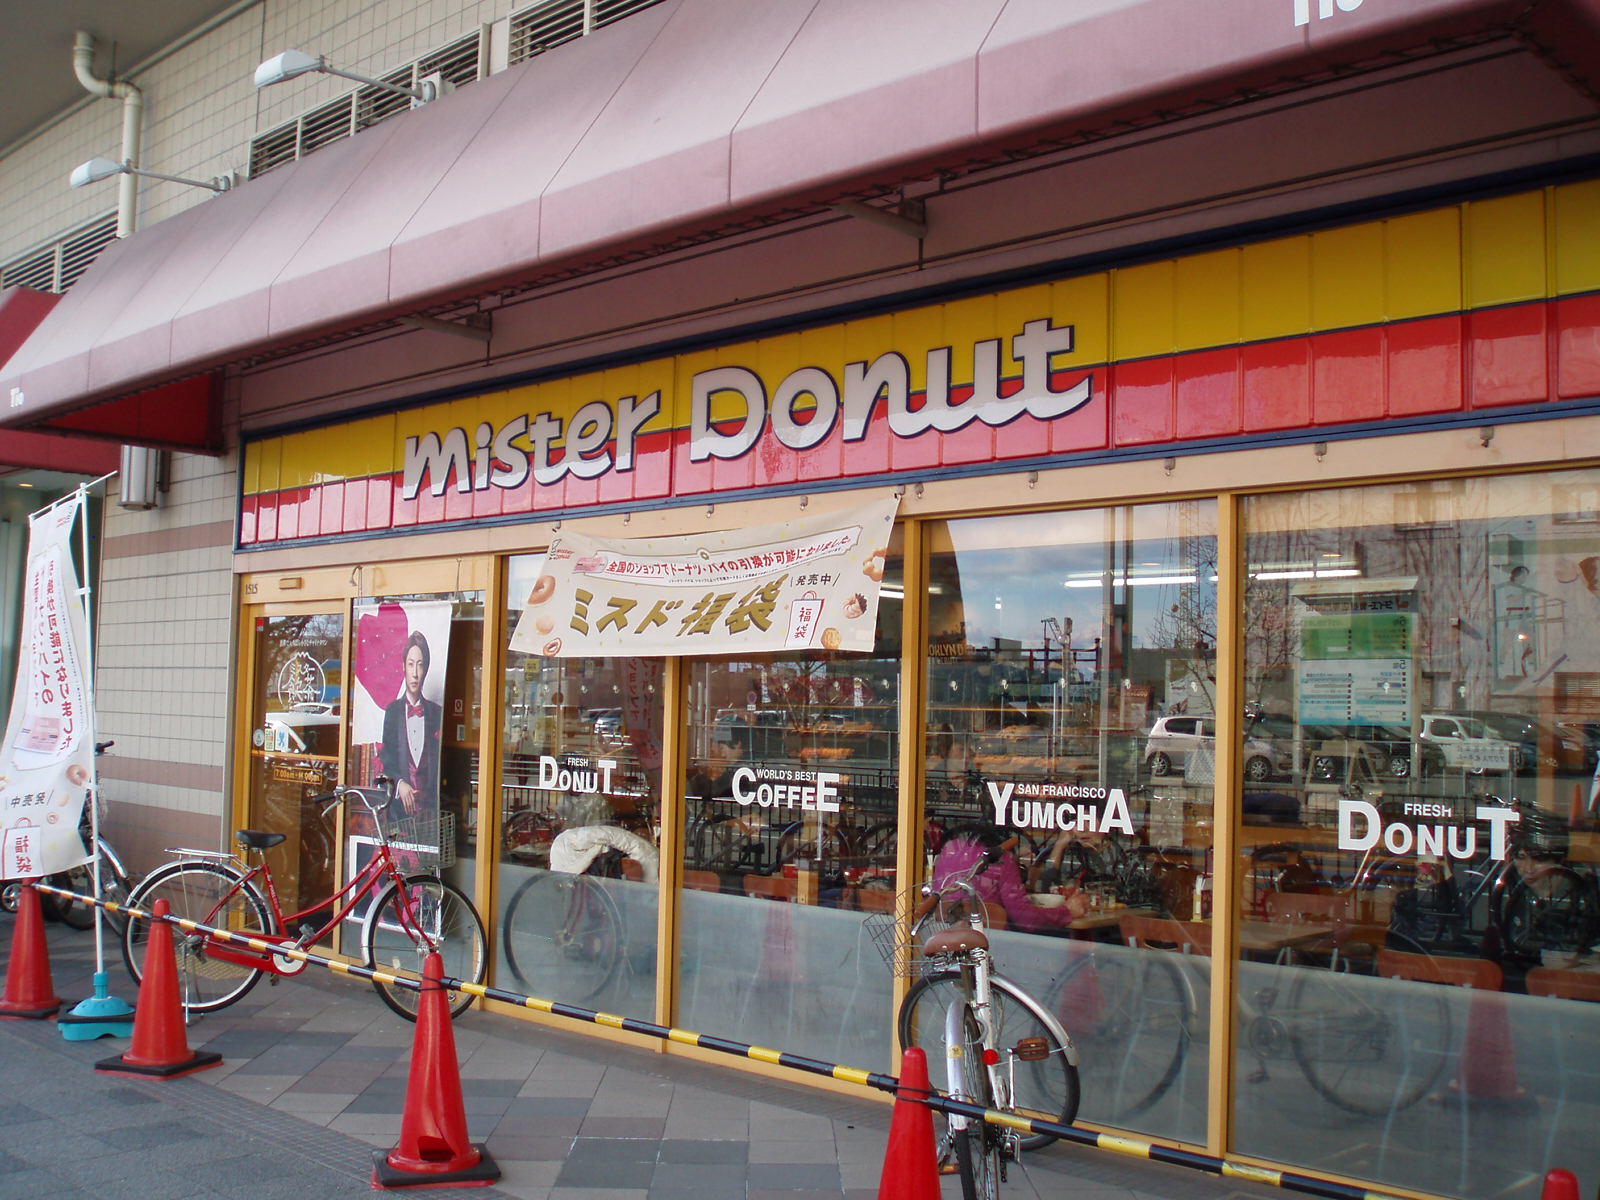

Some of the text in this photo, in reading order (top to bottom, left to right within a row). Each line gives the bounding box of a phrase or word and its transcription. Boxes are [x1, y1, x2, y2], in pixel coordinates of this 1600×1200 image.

[689, 317, 1093, 463] Donut
[245, 584, 258, 595] 1515
[795, 572, 832, 587] 発売中
[570, 573, 789, 637] ミスド福袋
[794, 606, 812, 639] 福袋
[539, 754, 617, 795] DONUT
[567, 756, 589, 767] FRESH
[756, 768, 817, 782] WORLD'S BEST
[731, 766, 840, 812] COFFEE
[1018, 783, 1106, 799] SAN FRANCISCO
[987, 782, 1135, 836] YUMCHA
[1404, 802, 1452, 818] FRESH
[1338, 799, 1520, 861] DONUT
